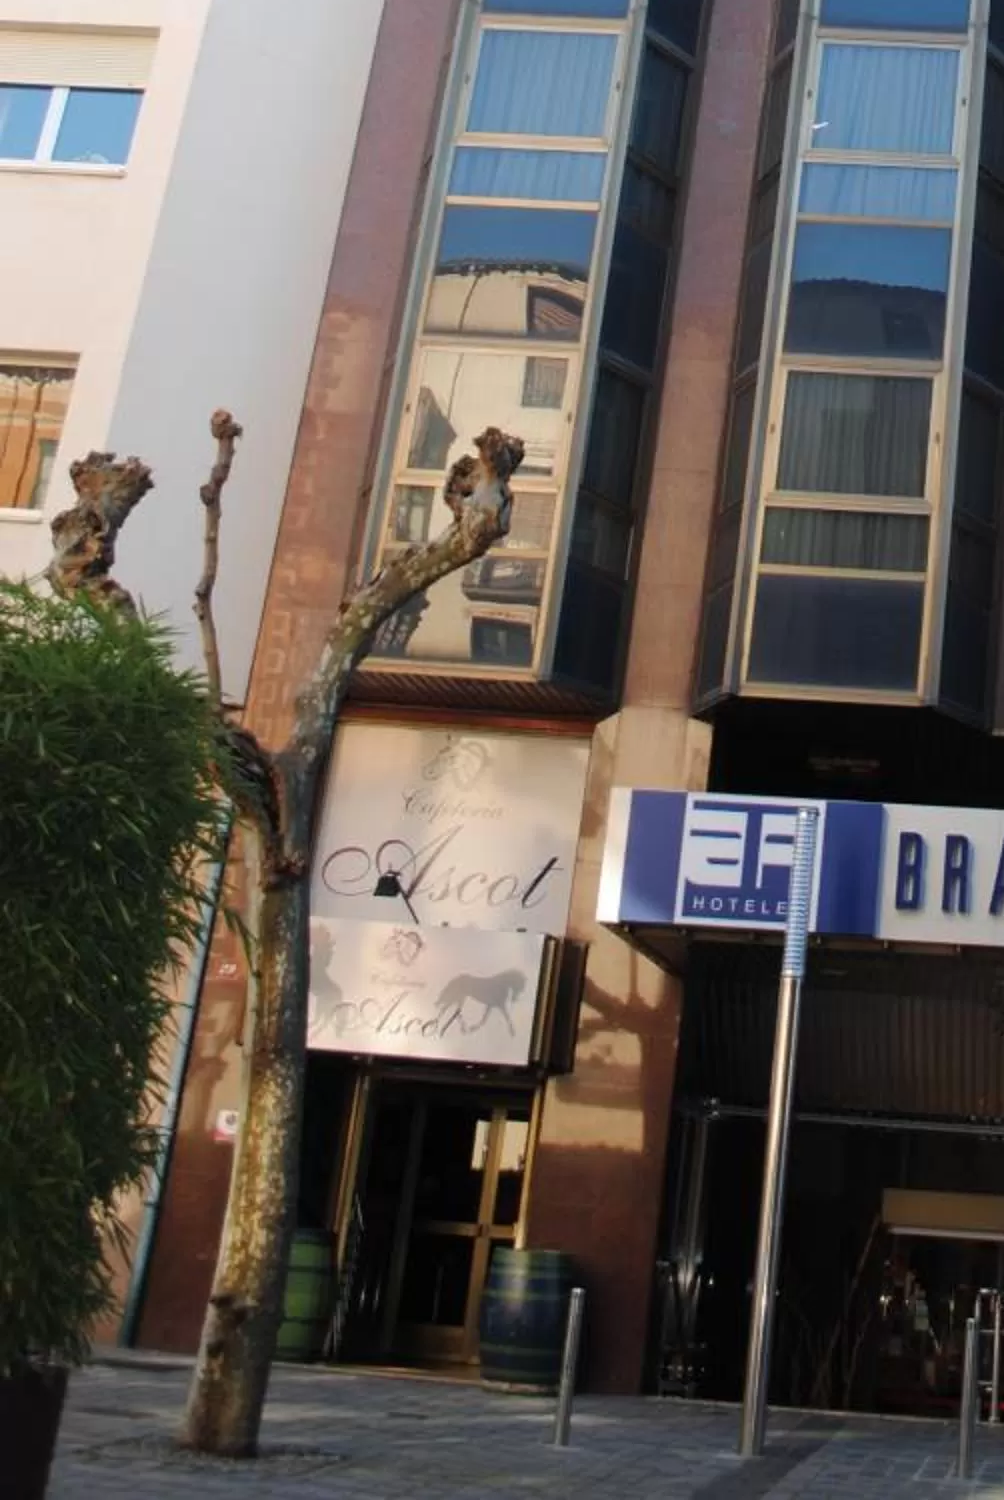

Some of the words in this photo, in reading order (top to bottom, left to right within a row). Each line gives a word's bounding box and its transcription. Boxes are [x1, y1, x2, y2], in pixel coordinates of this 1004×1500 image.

[321, 825, 564, 909] Ascot
[692, 896, 800, 917] HOTELE
[332, 991, 466, 1039] Ascot
